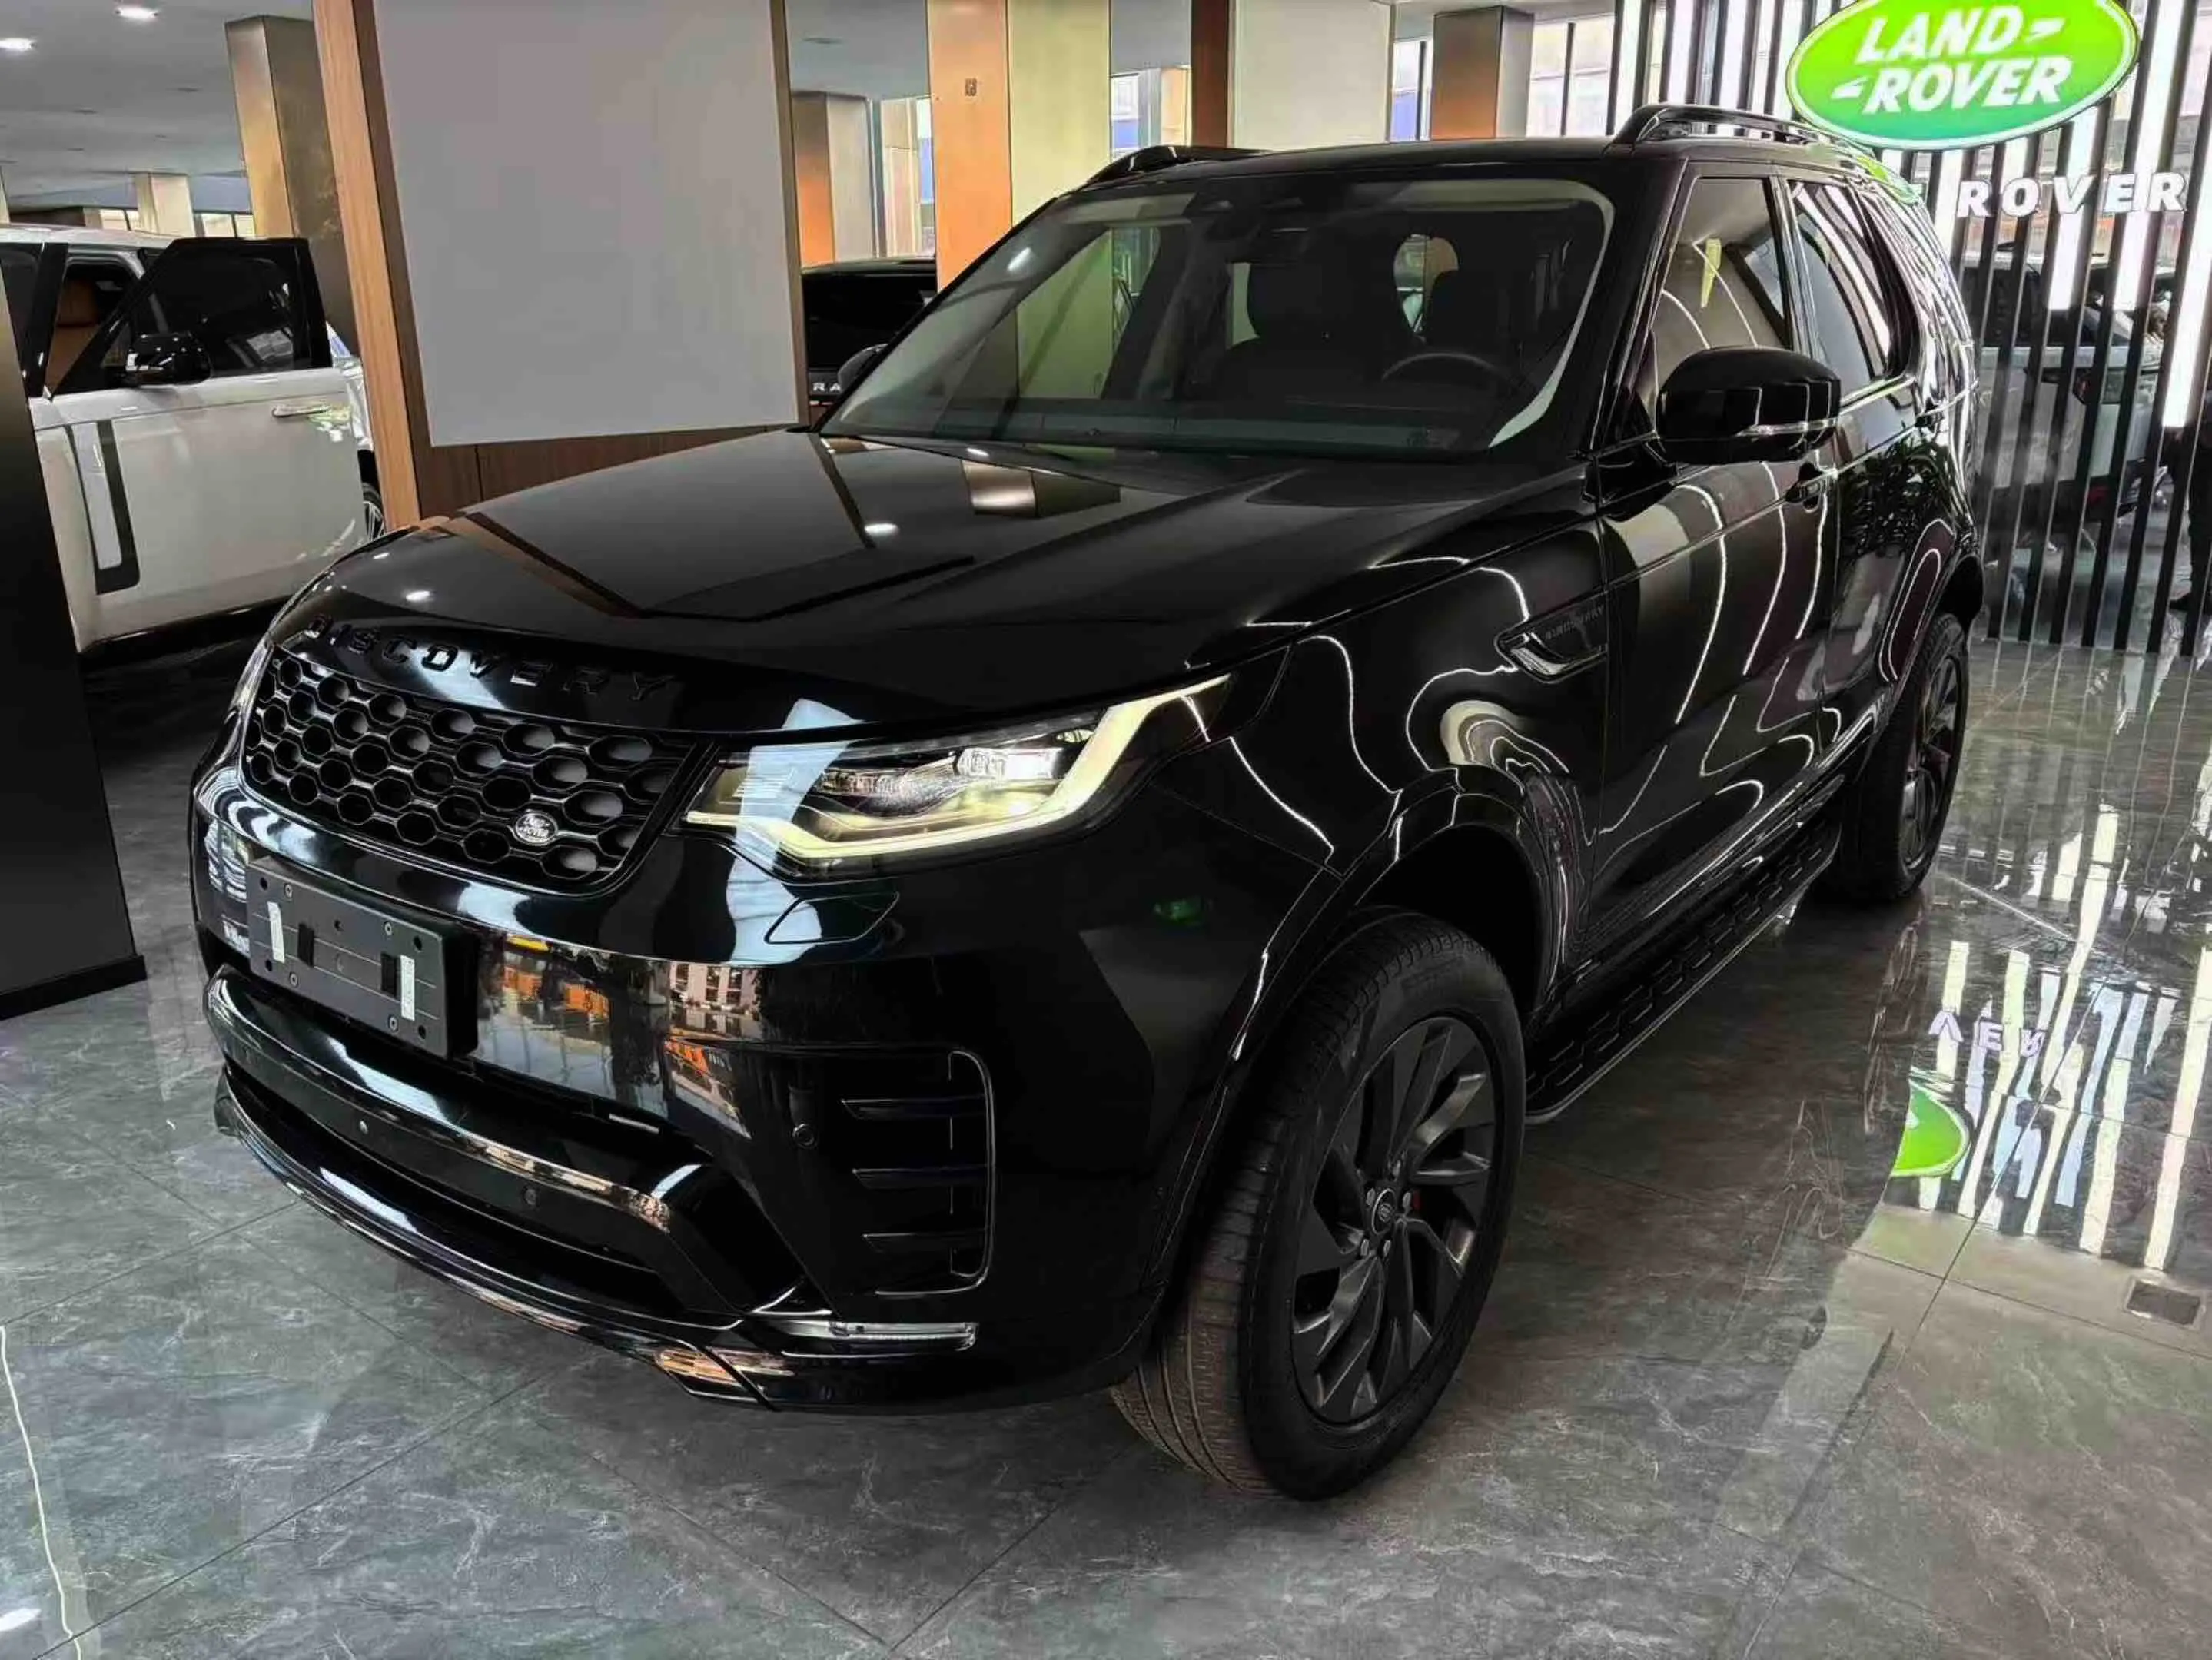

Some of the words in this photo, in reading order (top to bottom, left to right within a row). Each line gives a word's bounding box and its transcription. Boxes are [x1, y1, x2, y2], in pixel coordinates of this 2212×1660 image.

[1855, 6, 2024, 65] LAND
[1862, 55, 2073, 114] ROVER
[1957, 172, 2187, 217] ROVER
[305, 614, 676, 701] DISCOVERY
